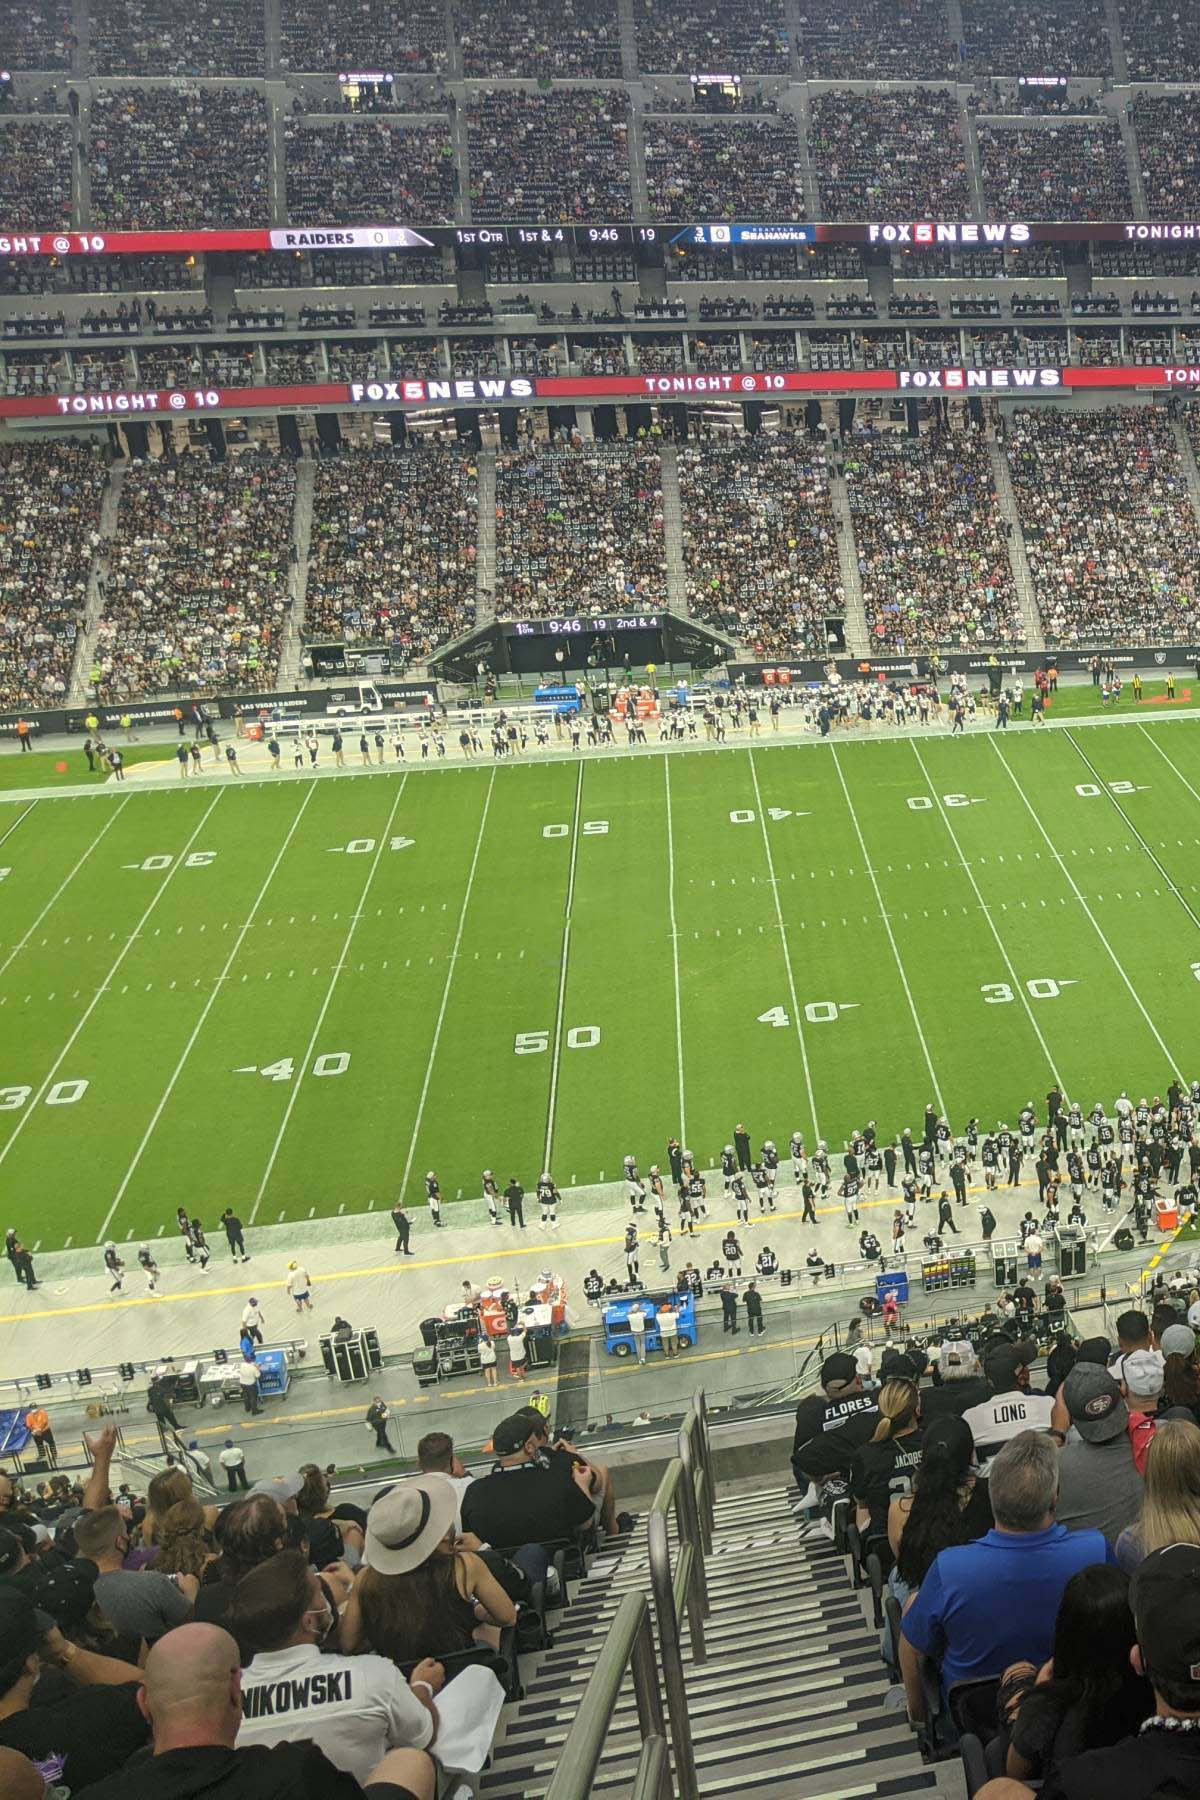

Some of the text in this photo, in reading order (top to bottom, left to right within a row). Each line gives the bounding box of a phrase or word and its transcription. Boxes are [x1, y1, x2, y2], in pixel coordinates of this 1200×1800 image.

[286, 231, 354, 245] RAIDERS
[373, 232, 384, 244] 0
[456, 228, 655, 244] 1ST QTR 1ST & 4 9:46 19
[741, 230, 806, 241] SEAHAWKS
[869, 224, 1029, 241] FOX 5 NEWS
[53, 237, 70, 253] @
[80, 236, 105, 251] 10
[645, 375, 785, 391] TONIGHT @ 10
[900, 369, 1060, 388] FOX 5 NEWS
[352, 379, 532, 401] FOX 5 NEWS
[58, 391, 219, 413] TONIGHT @ 10
[549, 619, 581, 633] 9:46
[592, 619, 606, 630] 19
[616, 616, 657, 629] 2nd & 4
[1074, 780, 1136, 797] 20
[906, 793, 969, 810] 30
[729, 807, 792, 823] 40
[542, 819, 610, 838] 50
[346, 836, 413, 854] 40
[140, 851, 217, 871] 30
[981, 977, 1062, 1004] 30
[756, 1001, 839, 1027] 40
[514, 1025, 601, 1055] 50
[259, 1052, 351, 1081] 40
[0, 1080, 89, 1110] 30
[539, 1189, 551, 1198] 79
[725, 1246, 736, 1255] 20
[761, 1256, 772, 1266] 21
[588, 1281, 599, 1291] 22
[824, 1397, 872, 1420] FLORES
[993, 1403, 1027, 1425] LONG
[894, 1449, 924, 1469] JACOBS
